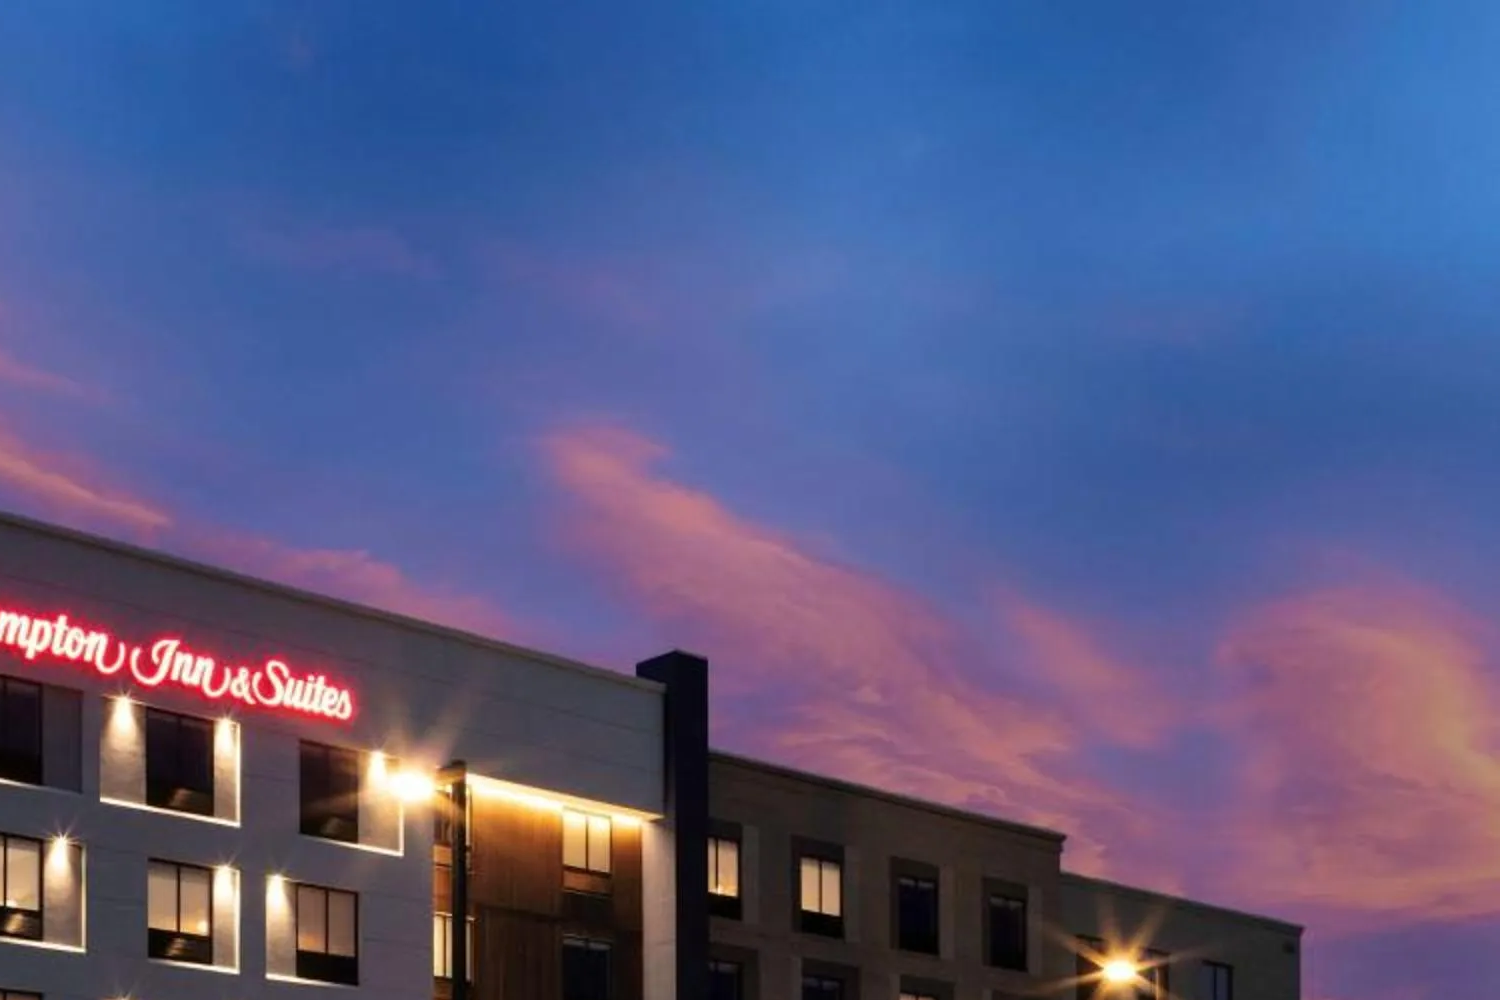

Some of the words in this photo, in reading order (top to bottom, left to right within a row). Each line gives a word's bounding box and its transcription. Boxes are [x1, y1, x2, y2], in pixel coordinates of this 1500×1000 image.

[130, 638, 231, 699] Inn
[230, 666, 256, 706] &
[252, 659, 353, 721] Suites
